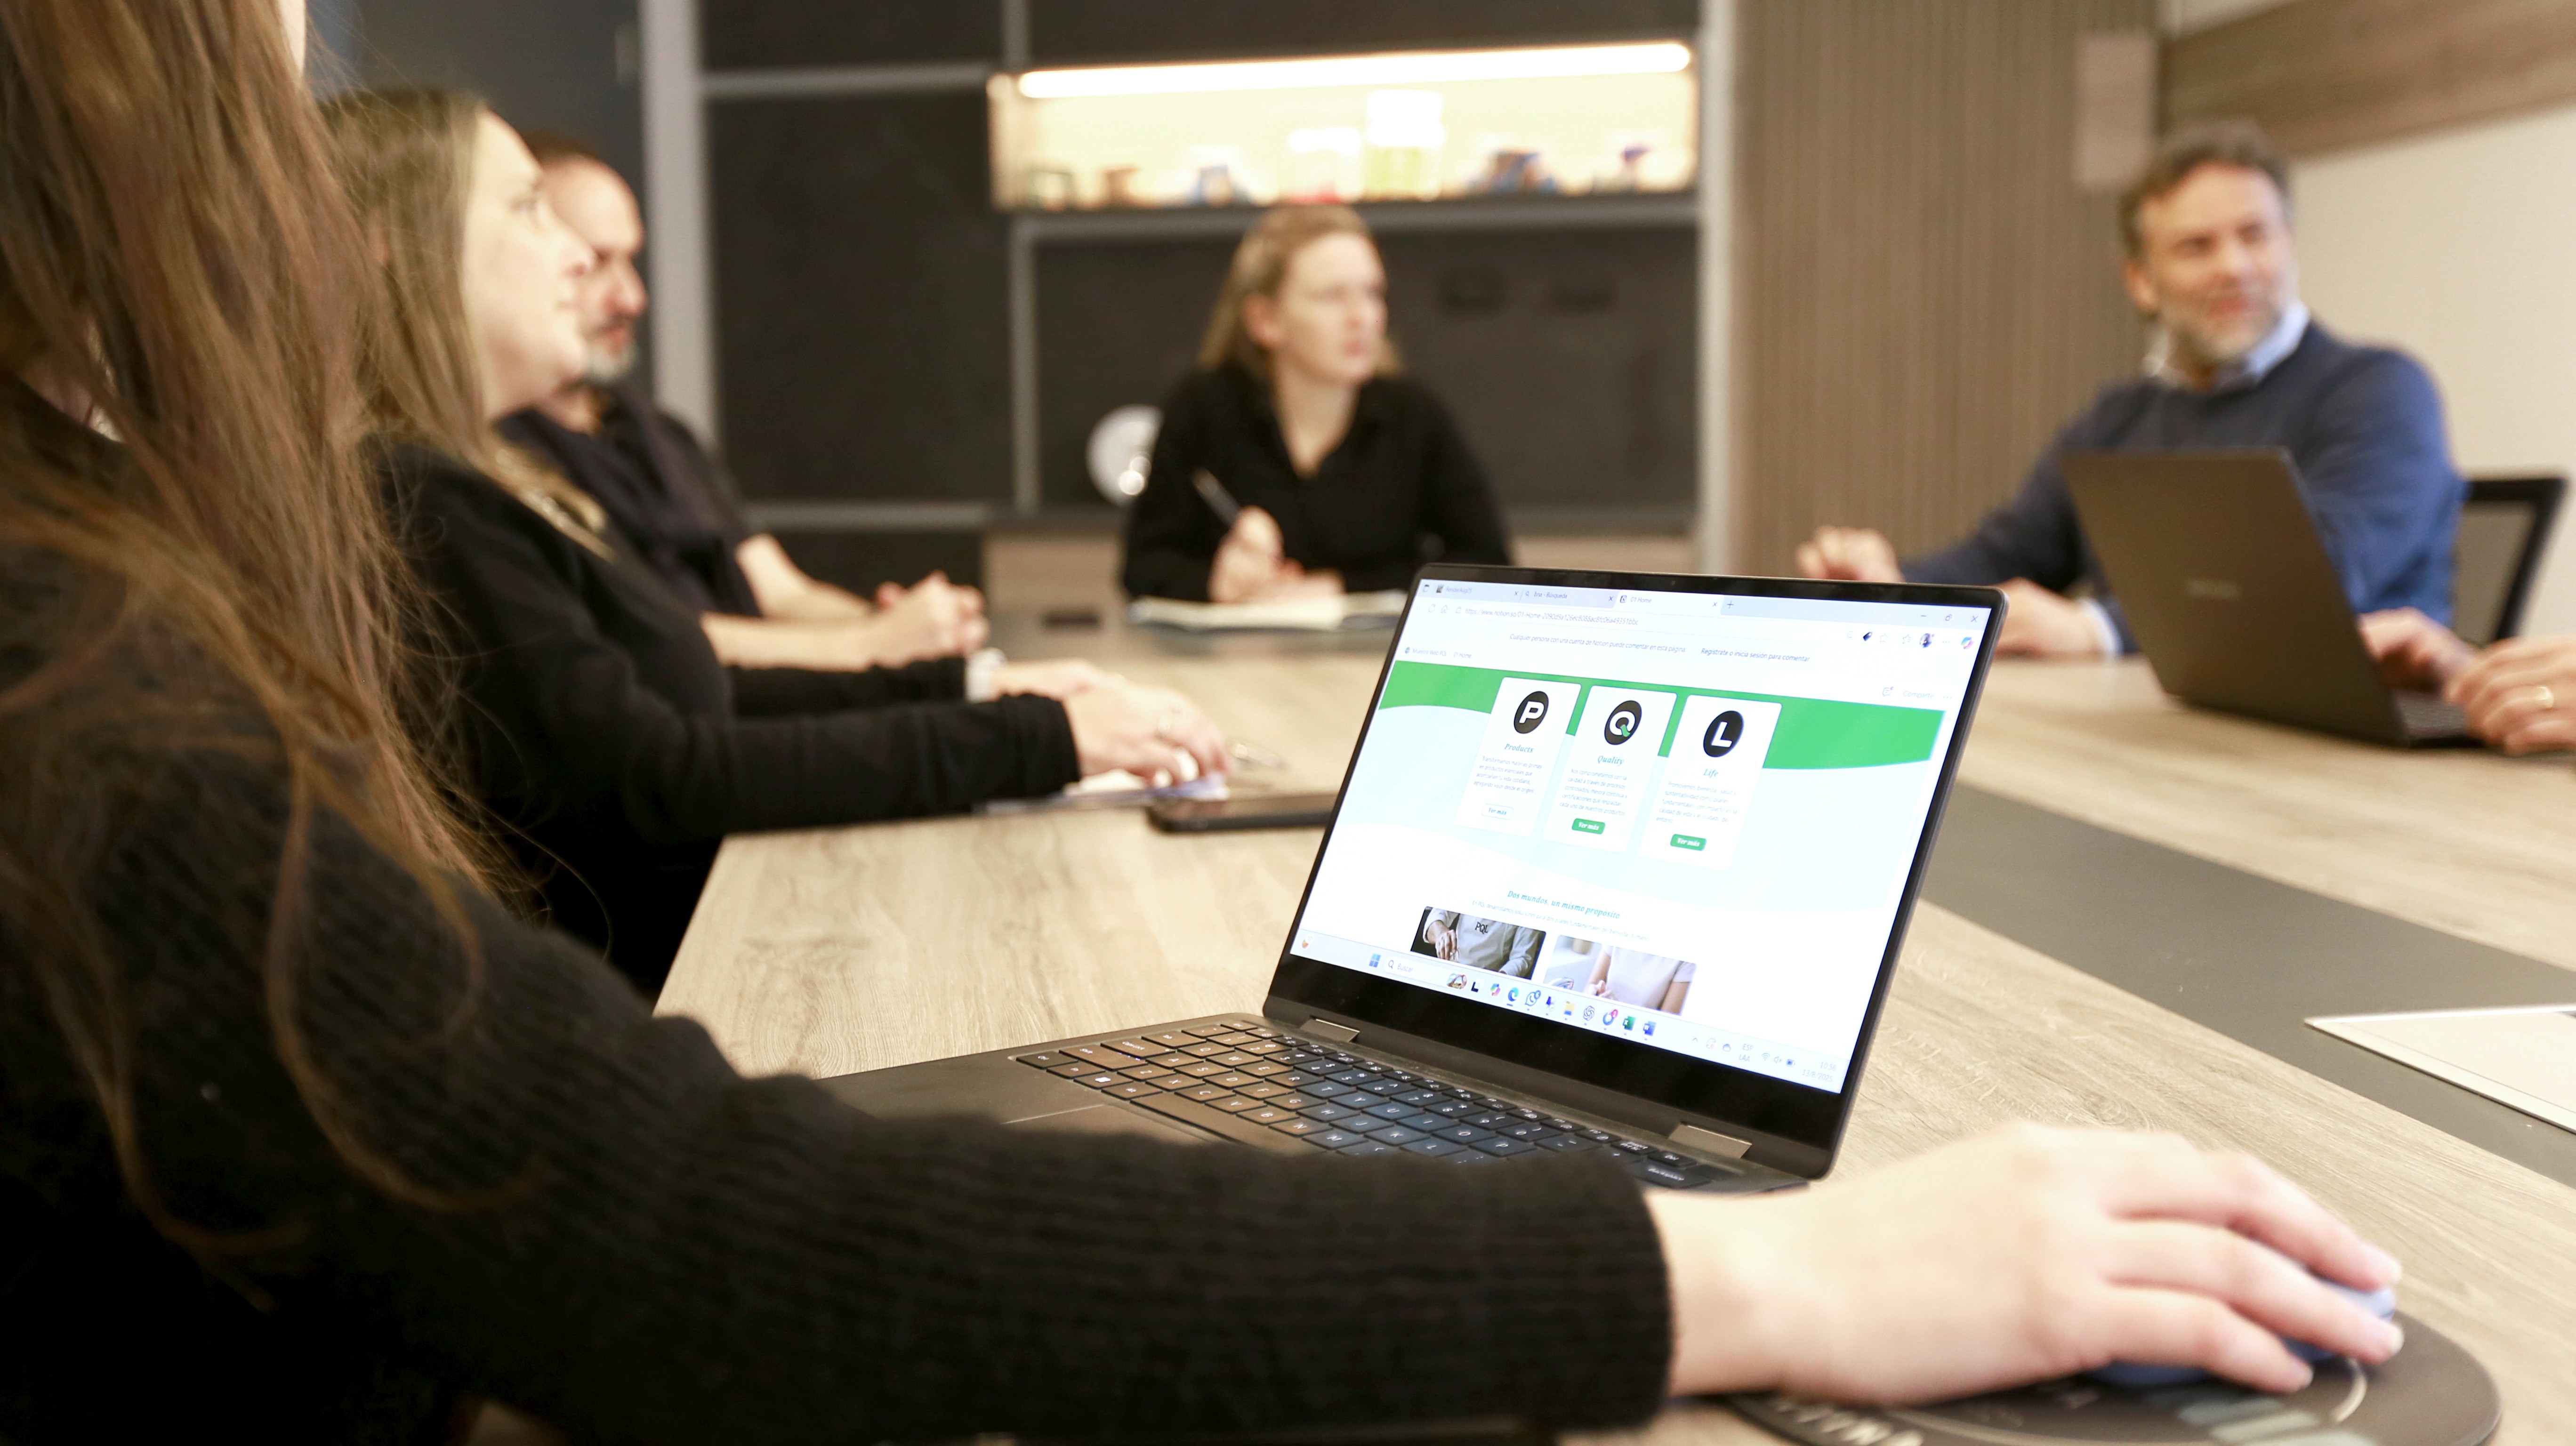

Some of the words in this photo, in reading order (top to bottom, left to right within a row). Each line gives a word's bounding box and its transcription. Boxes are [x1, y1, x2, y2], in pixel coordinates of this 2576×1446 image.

[1510, 633, 1530, 642] Cualquier
[1750, 651, 1768, 659] sesión
[1519, 701, 1544, 723] P
[1610, 711, 1635, 737] Q
[1711, 722, 1732, 747] L
[1504, 743, 1534, 753] Products
[1482, 756, 1510, 765] Transformamos
[1597, 755, 1624, 766] Quality
[1703, 769, 1719, 778] Life
[1667, 782, 1696, 790] Promovemos
[1562, 793, 1592, 803] certificaciones
[1602, 798, 1622, 806] respaldan
[1665, 791, 1699, 800] sustentabilidad
[1507, 891, 1520, 899] Dos
[1521, 894, 1549, 905] mundos,
[1562, 901, 1585, 913] mismo
[1585, 906, 1620, 919] propósito
[1475, 922, 1489, 934] PQL
[1397, 964, 1413, 972] Buscar
[1739, 1054, 1750, 1062] LAA
